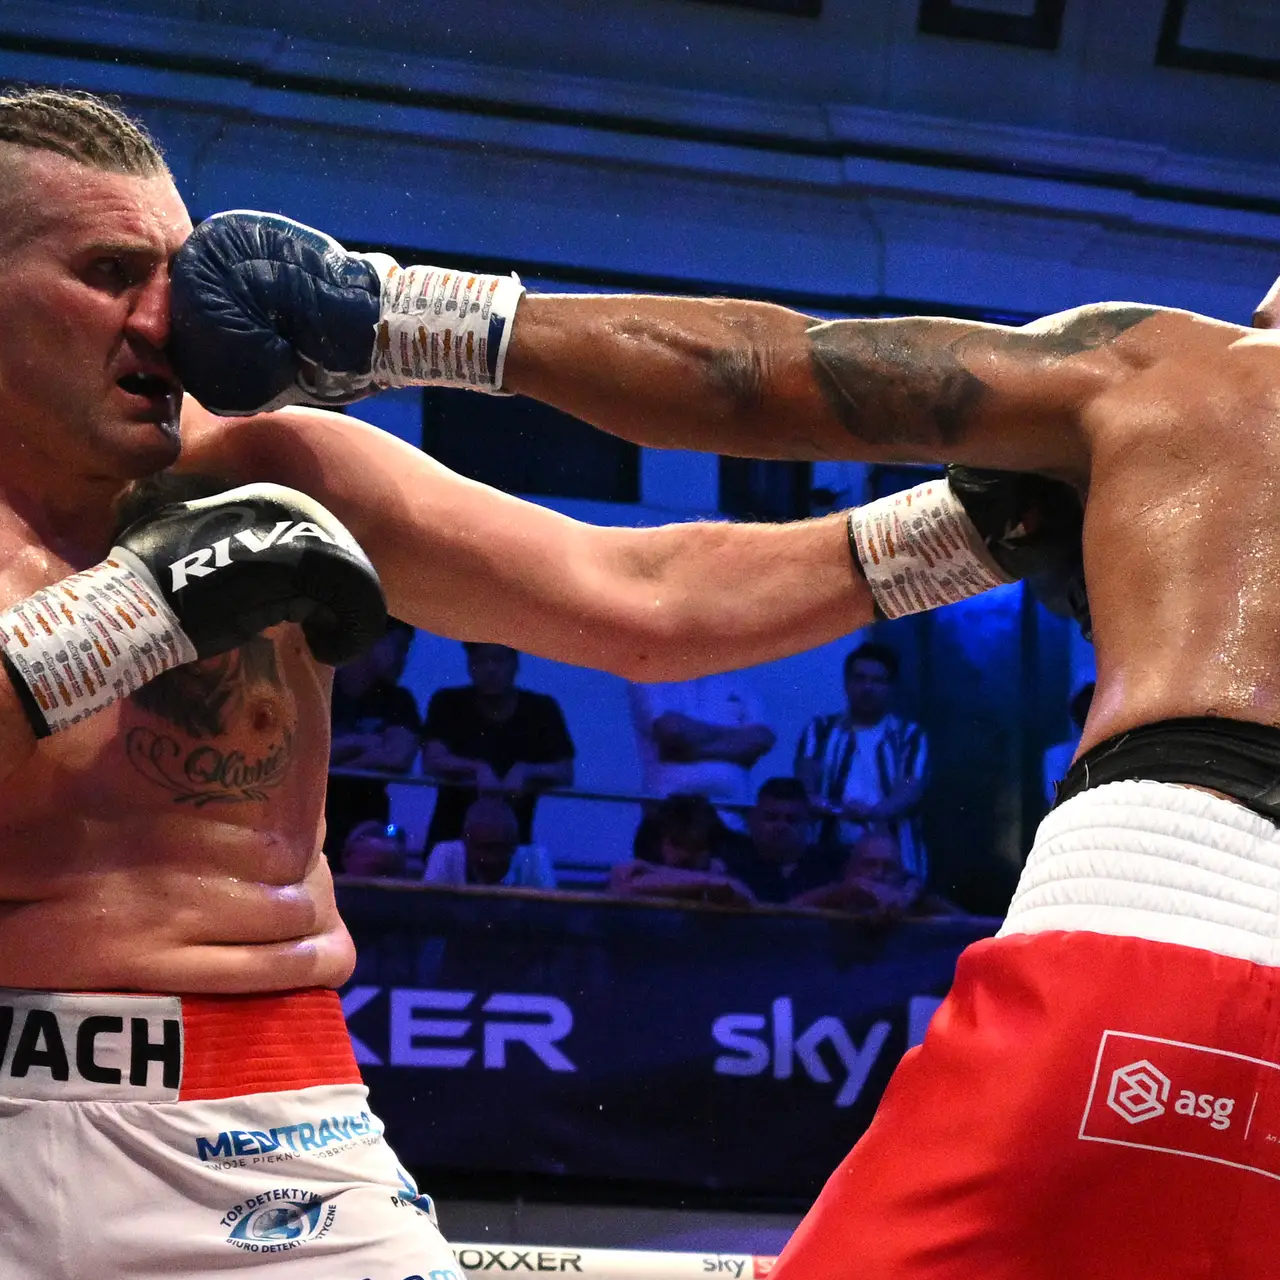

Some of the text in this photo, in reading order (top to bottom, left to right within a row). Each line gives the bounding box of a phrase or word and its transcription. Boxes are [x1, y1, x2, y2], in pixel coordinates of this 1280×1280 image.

[711, 997, 891, 1107] sky
[1174, 1087, 1236, 1131] asg
[1265, 1132, 1278, 1142] An
[220, 1188, 324, 1228] TOP DETEKTYW
[226, 1238, 259, 1253] BIURO
[702, 1255, 746, 1279] sky
